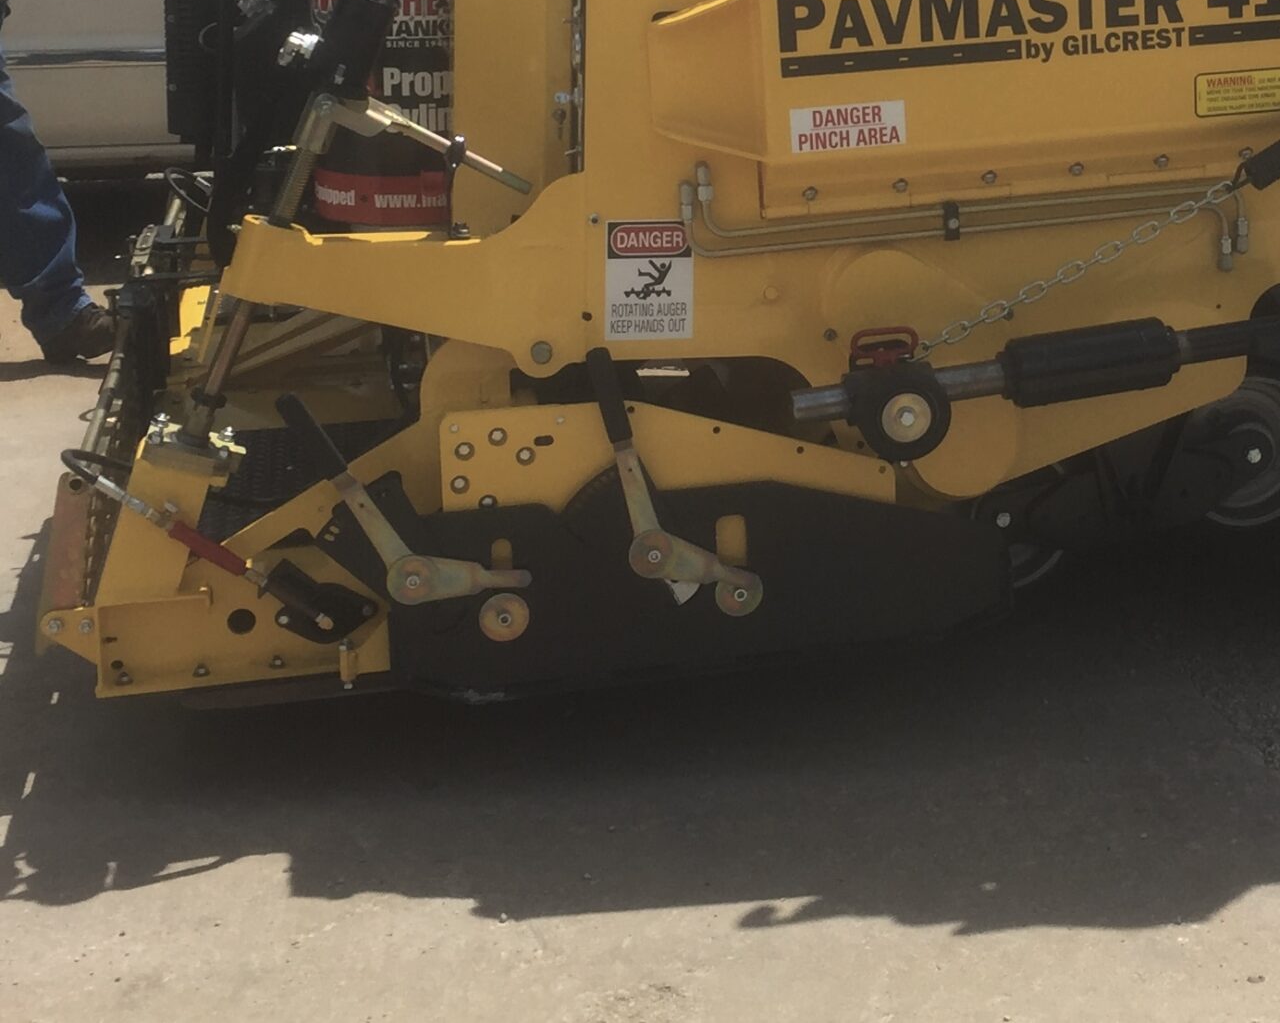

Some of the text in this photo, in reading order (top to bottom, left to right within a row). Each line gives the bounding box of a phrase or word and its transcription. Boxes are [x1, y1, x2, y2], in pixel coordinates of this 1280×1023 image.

[385, 40, 449, 49] SINCE 194
[1026, 27, 1186, 63] by GILCREST
[812, 105, 882, 128] DANGER
[798, 126, 901, 151] PINCH AREA
[616, 231, 684, 248] DANGER
[611, 302, 687, 317] ROTATING AUGER
[610, 318, 686, 334] KEEP HANDS OUT
